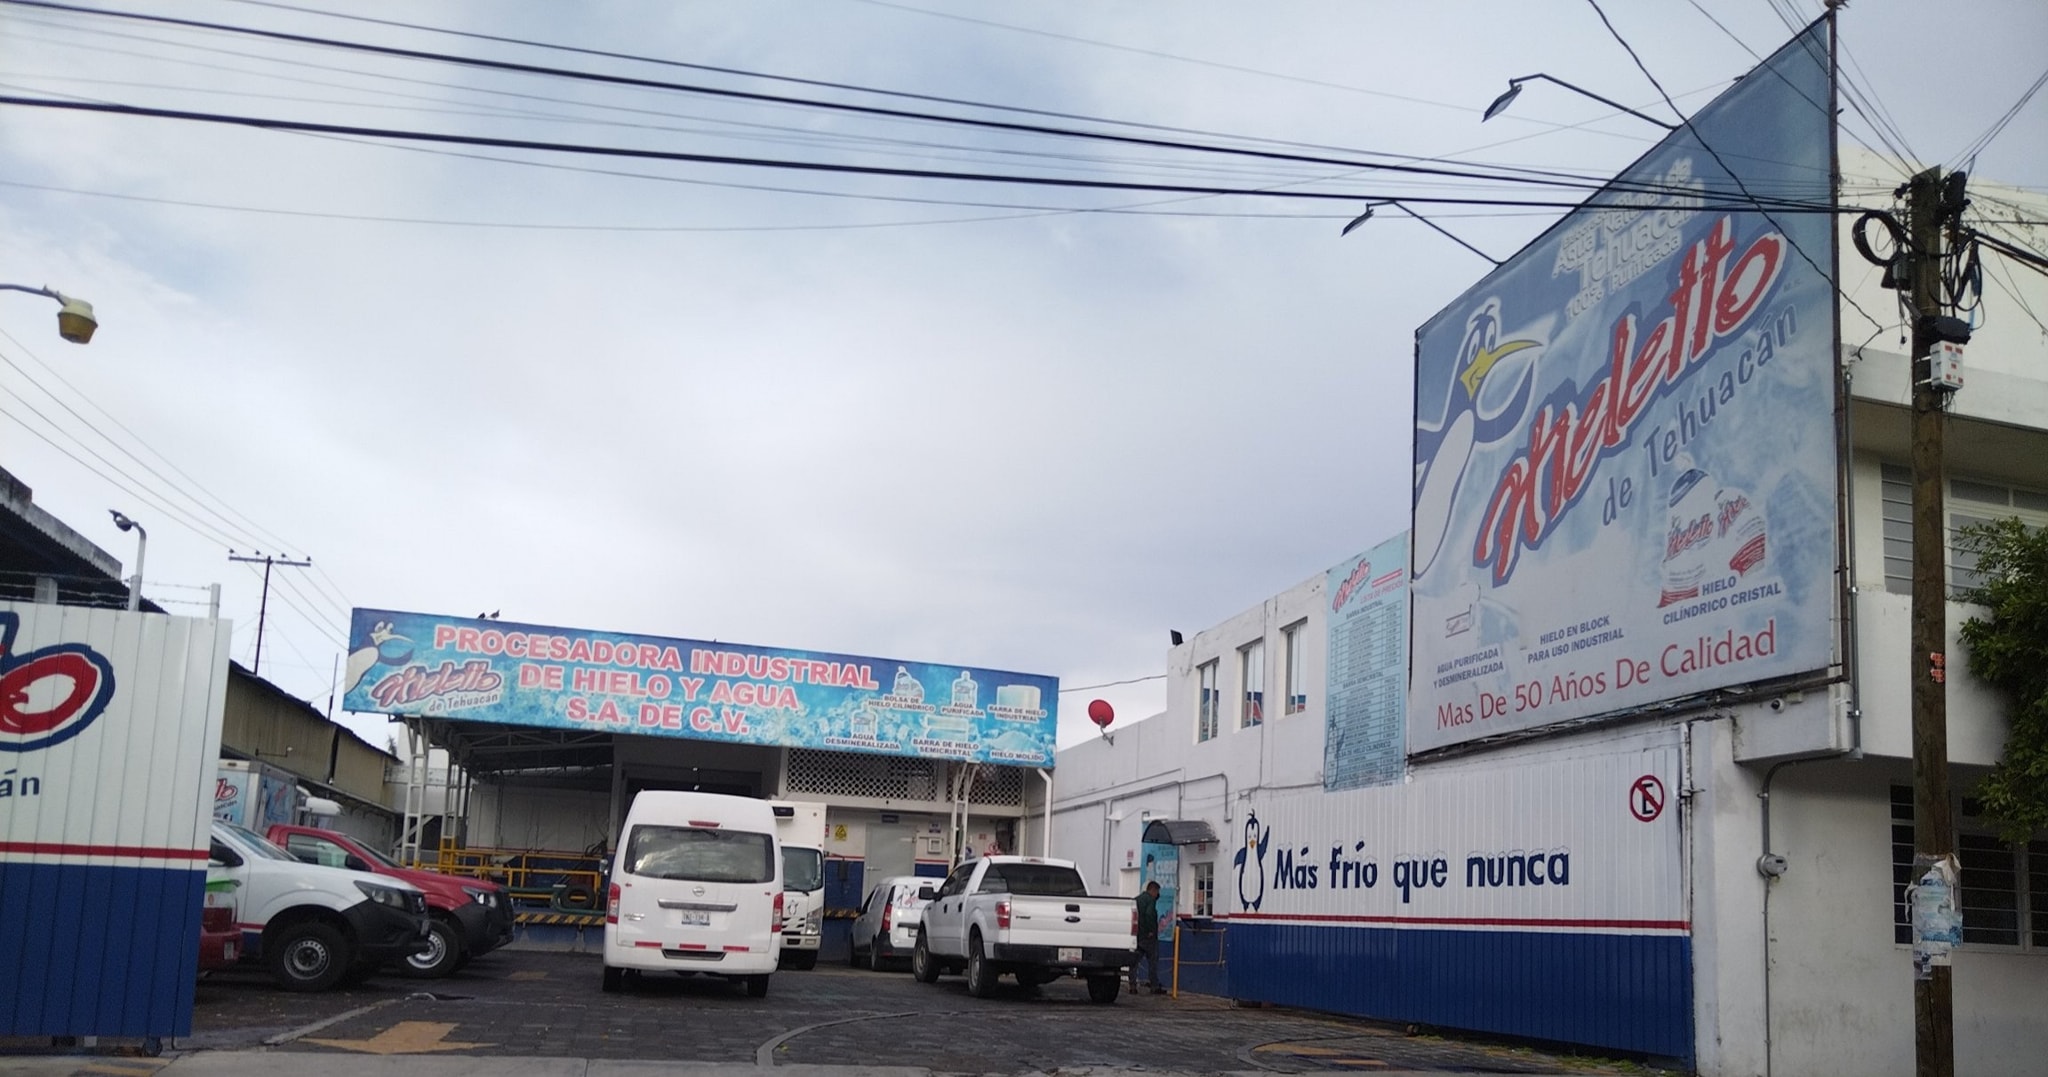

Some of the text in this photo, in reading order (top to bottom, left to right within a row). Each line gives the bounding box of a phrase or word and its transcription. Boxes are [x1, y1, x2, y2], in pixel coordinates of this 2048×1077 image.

[1476, 212, 1787, 583] Hieletto
[1603, 303, 1798, 526] de Tehuacán
[1702, 576, 1737, 597] HIELO
[1663, 582, 1782, 625] CILÍNDRICO CRISTAL
[1540, 615, 1610, 645] HIELO EN BLOCK
[435, 624, 879, 690] PROCESADORA INDUSTRIAL
[1528, 628, 1624, 664] PARA USO INDUSTRIAL
[1437, 648, 1499, 675] AGUA PURIFICADA
[520, 664, 798, 709] DE HIELO Y AGUA
[1433, 661, 1504, 689] Y DESMINERALIZADA
[1437, 702, 1473, 730] Mas
[1480, 691, 1507, 720] De
[1515, 680, 1542, 712] 50
[1549, 671, 1606, 704] Años
[1616, 658, 1650, 690] De
[1660, 619, 1776, 678] Calidad
[429, 692, 498, 712] de Tehuacán
[868, 700, 890, 708] HIELO
[884, 695, 908, 704] BOLSA
[989, 705, 1013, 714] BARRA
[1024, 709, 1046, 717] HIELO
[567, 697, 748, 733] S.A. DE C.V.
[942, 707, 985, 717] PURIFICADA
[996, 713, 1038, 722] INDUSTRIAL
[825, 738, 900, 750] DESMINERALIZADA
[852, 733, 875, 741] AGUA
[913, 738, 940, 747] BARRA
[955, 742, 979, 750] HIELO
[919, 746, 972, 757] SEMICRISTAL
[991, 751, 1045, 761] HIELO MOLIDO
[1273, 840, 1572, 904] Más frío que nunca
